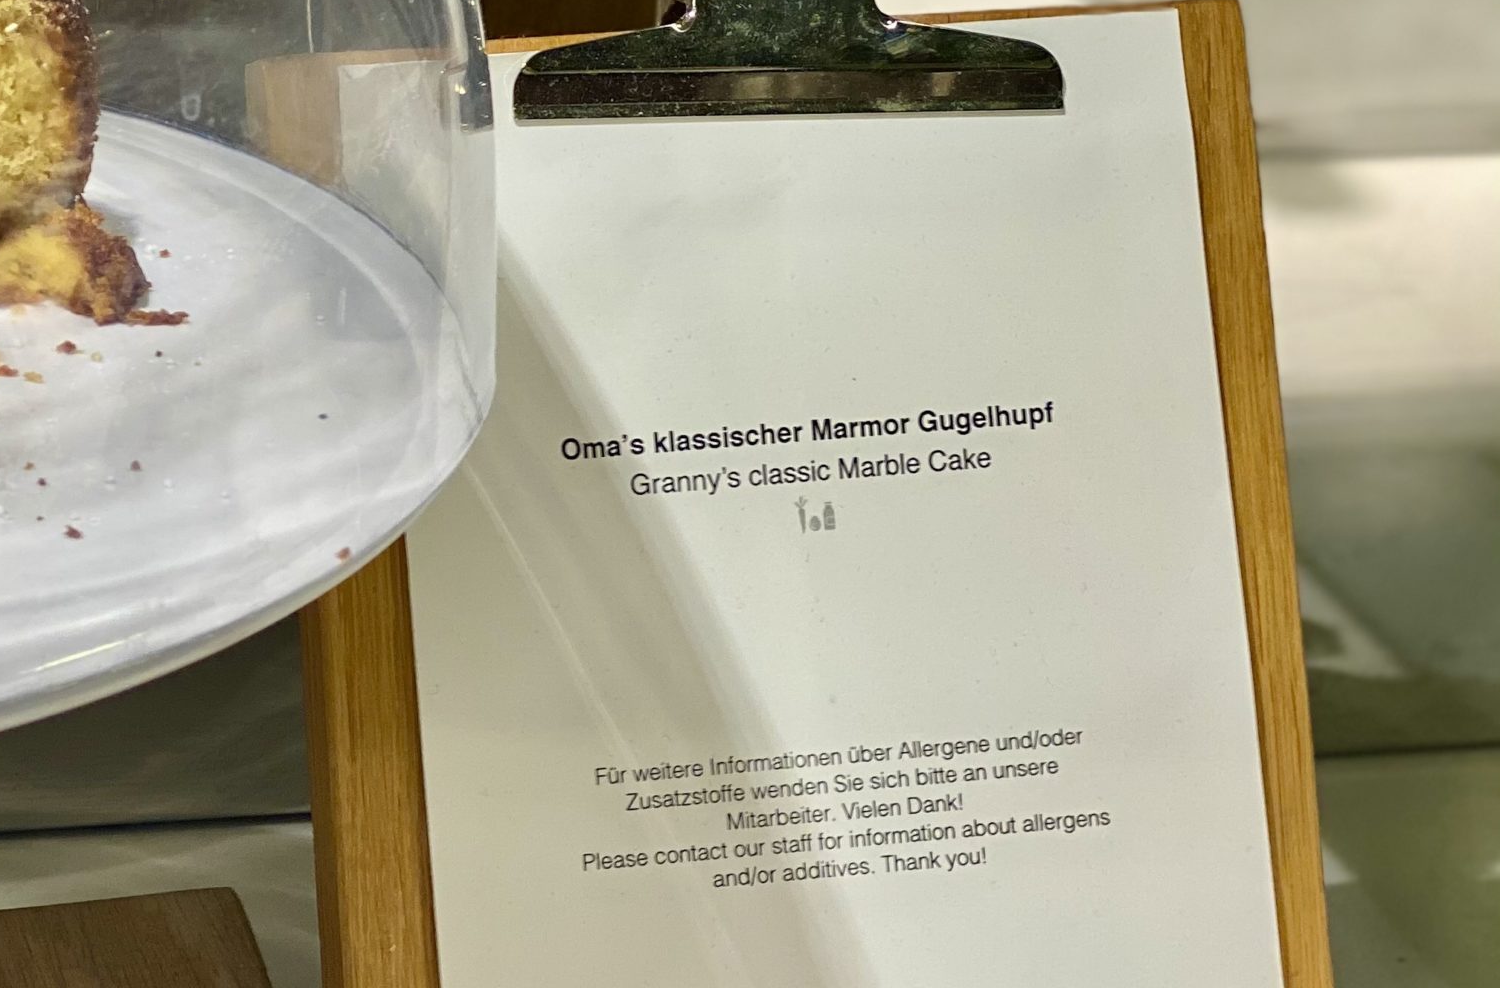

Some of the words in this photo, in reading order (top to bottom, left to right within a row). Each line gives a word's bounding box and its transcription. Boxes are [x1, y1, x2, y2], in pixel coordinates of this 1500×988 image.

[561, 434, 645, 460] Oma's
[653, 423, 803, 453] klassischer
[811, 418, 910, 441] Marmor
[918, 401, 1053, 435] Gugelhupf
[630, 467, 741, 495] Granny's
[748, 460, 831, 486] classic
[838, 453, 921, 479] Marble
[928, 448, 992, 472] Cake
[594, 766, 627, 786] Für
[632, 762, 703, 783] weitere
[710, 751, 842, 776] Informationen
[848, 744, 893, 764] über
[898, 738, 990, 761] Allergene
[996, 728, 1083, 752] und/oder
[625, 786, 745, 813] Zusatzstoffe
[751, 777, 828, 800] wenden
[834, 773, 864, 794] Sie
[869, 769, 910, 790] sich
[915, 766, 957, 786] bitte
[963, 766, 987, 782] an
[992, 760, 1059, 780] unsere
[727, 806, 836, 831] Mitarbeiter.
[841, 799, 901, 821] Vielen
[907, 792, 963, 816] Dank!
[582, 852, 648, 872] Please
[654, 842, 728, 866] contact
[734, 841, 765, 858] our
[772, 832, 812, 855] staff
[818, 832, 843, 851] for
[849, 823, 956, 849] information
[962, 816, 1017, 839] about
[1023, 811, 1111, 834] allergens
[713, 865, 776, 889] and/or
[783, 859, 875, 882] additives.
[880, 850, 941, 873] Thank
[945, 846, 986, 873] you!
